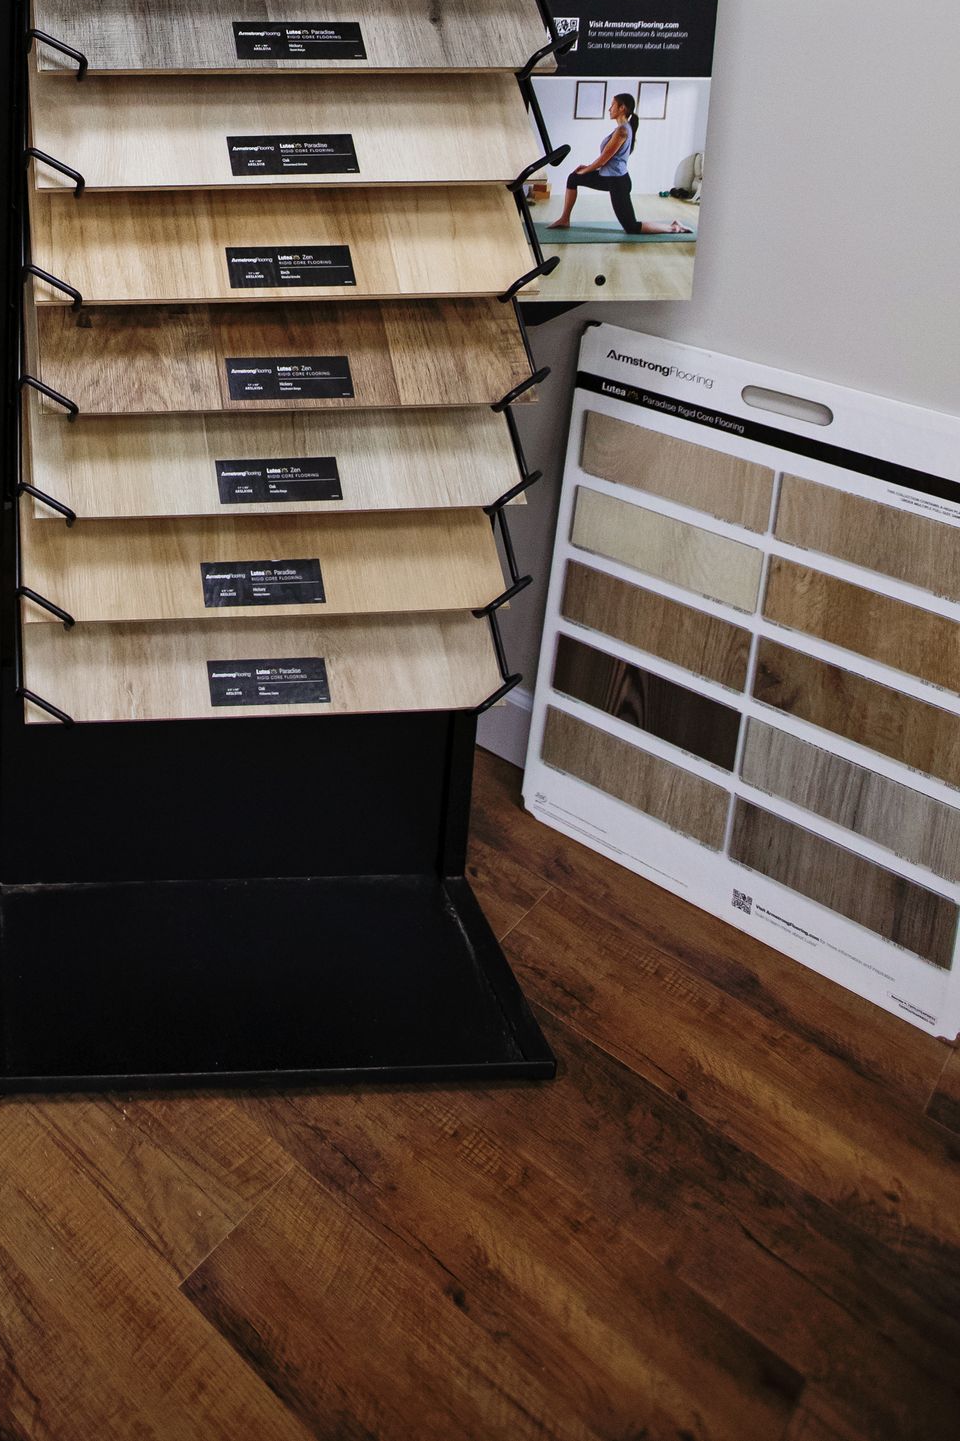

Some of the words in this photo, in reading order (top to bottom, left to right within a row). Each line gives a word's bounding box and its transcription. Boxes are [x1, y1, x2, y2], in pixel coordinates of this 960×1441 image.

[589, 20, 603, 28] Visit
[604, 20, 680, 30] ArmstrongFlooring.com
[588, 30, 596, 38] for
[614, 30, 650, 38] information
[656, 30, 689, 40] inspiration
[587, 41, 602, 50] Scan
[603, 42, 610, 50] to
[611, 42, 626, 50] learn
[644, 42, 662, 51] about
[606, 349, 714, 390] ArmstrongFlooring
[601, 381, 627, 397] Lutea
[642, 394, 677, 412] Paradise
[677, 405, 696, 418] Rigid
[696, 411, 714, 424] Core
[715, 416, 745, 434] Flooring
